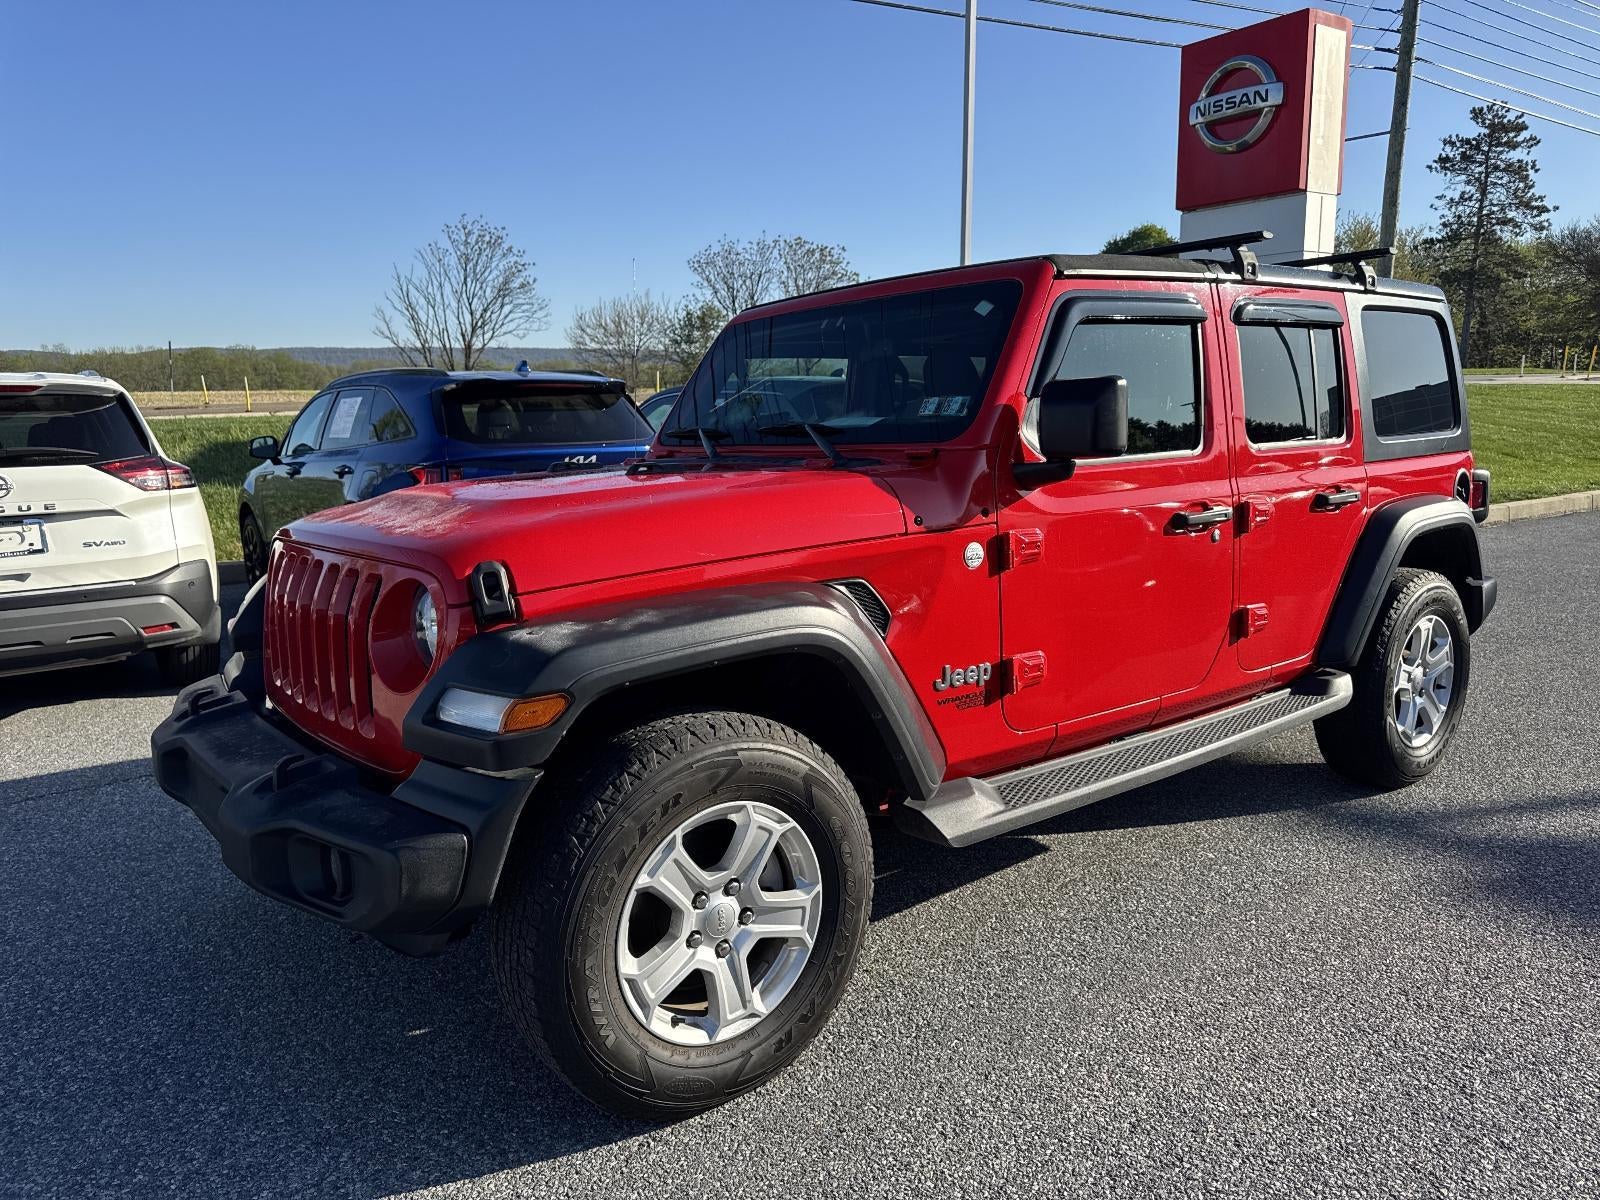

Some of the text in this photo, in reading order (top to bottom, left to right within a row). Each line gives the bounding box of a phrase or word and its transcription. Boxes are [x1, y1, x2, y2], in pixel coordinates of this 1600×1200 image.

[1195, 88, 1269, 119] NISSAN
[82, 540, 104, 548] SV
[934, 661, 992, 692] Jeep
[936, 688, 992, 706] WRANGL
[583, 791, 684, 1050] WRANGLER
[772, 816, 857, 1055] GOODYEAR
